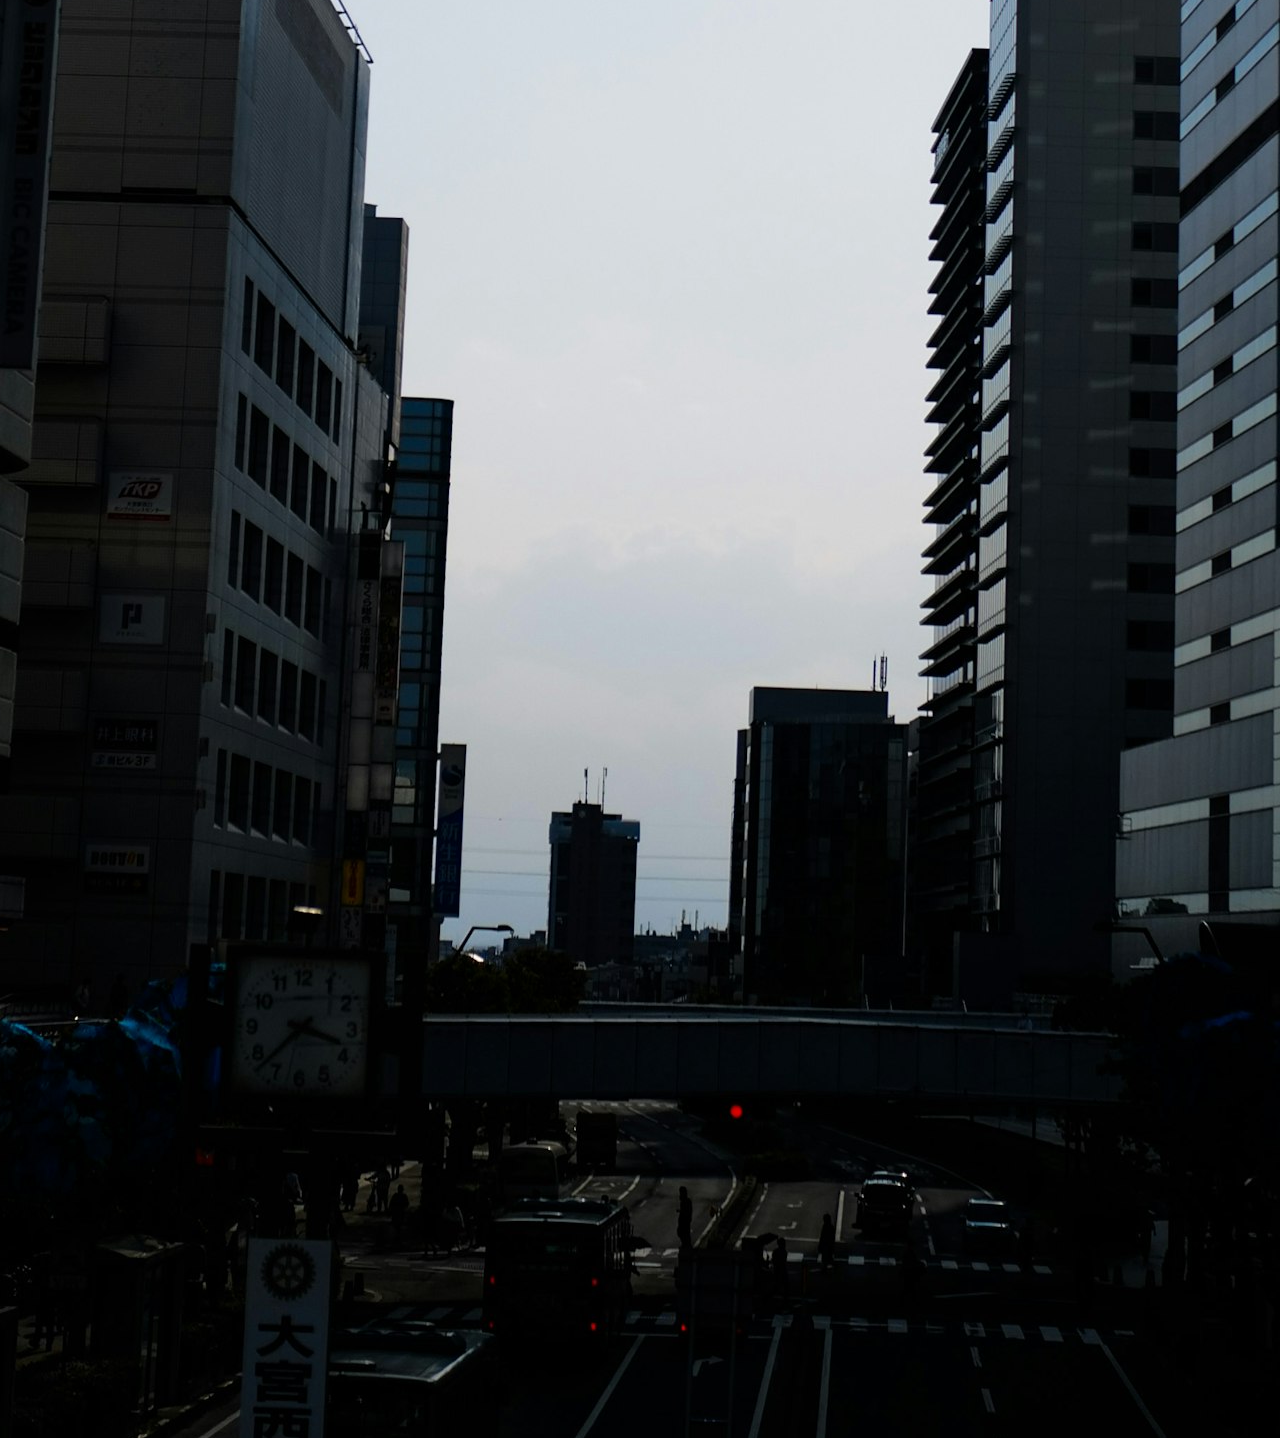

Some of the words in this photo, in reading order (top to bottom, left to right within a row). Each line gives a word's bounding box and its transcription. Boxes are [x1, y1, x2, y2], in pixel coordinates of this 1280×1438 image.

[3, 220, 32, 336] CAMERA
[122, 482, 159, 497] TKP
[437, 821, 460, 907] 新生銀行
[272, 974, 287, 991] 11
[294, 969, 313, 986] 12
[325, 976, 333, 995] 1
[254, 993, 273, 1010] 10
[340, 995, 351, 1012] 2
[246, 1018, 258, 1035] 9
[346, 1021, 357, 1038] 3
[252, 1044, 264, 1060] 8
[337, 1048, 348, 1064] 4
[271, 1064, 282, 1081] 7
[293, 1070, 305, 1087] 6
[318, 1065, 329, 1082] 5
